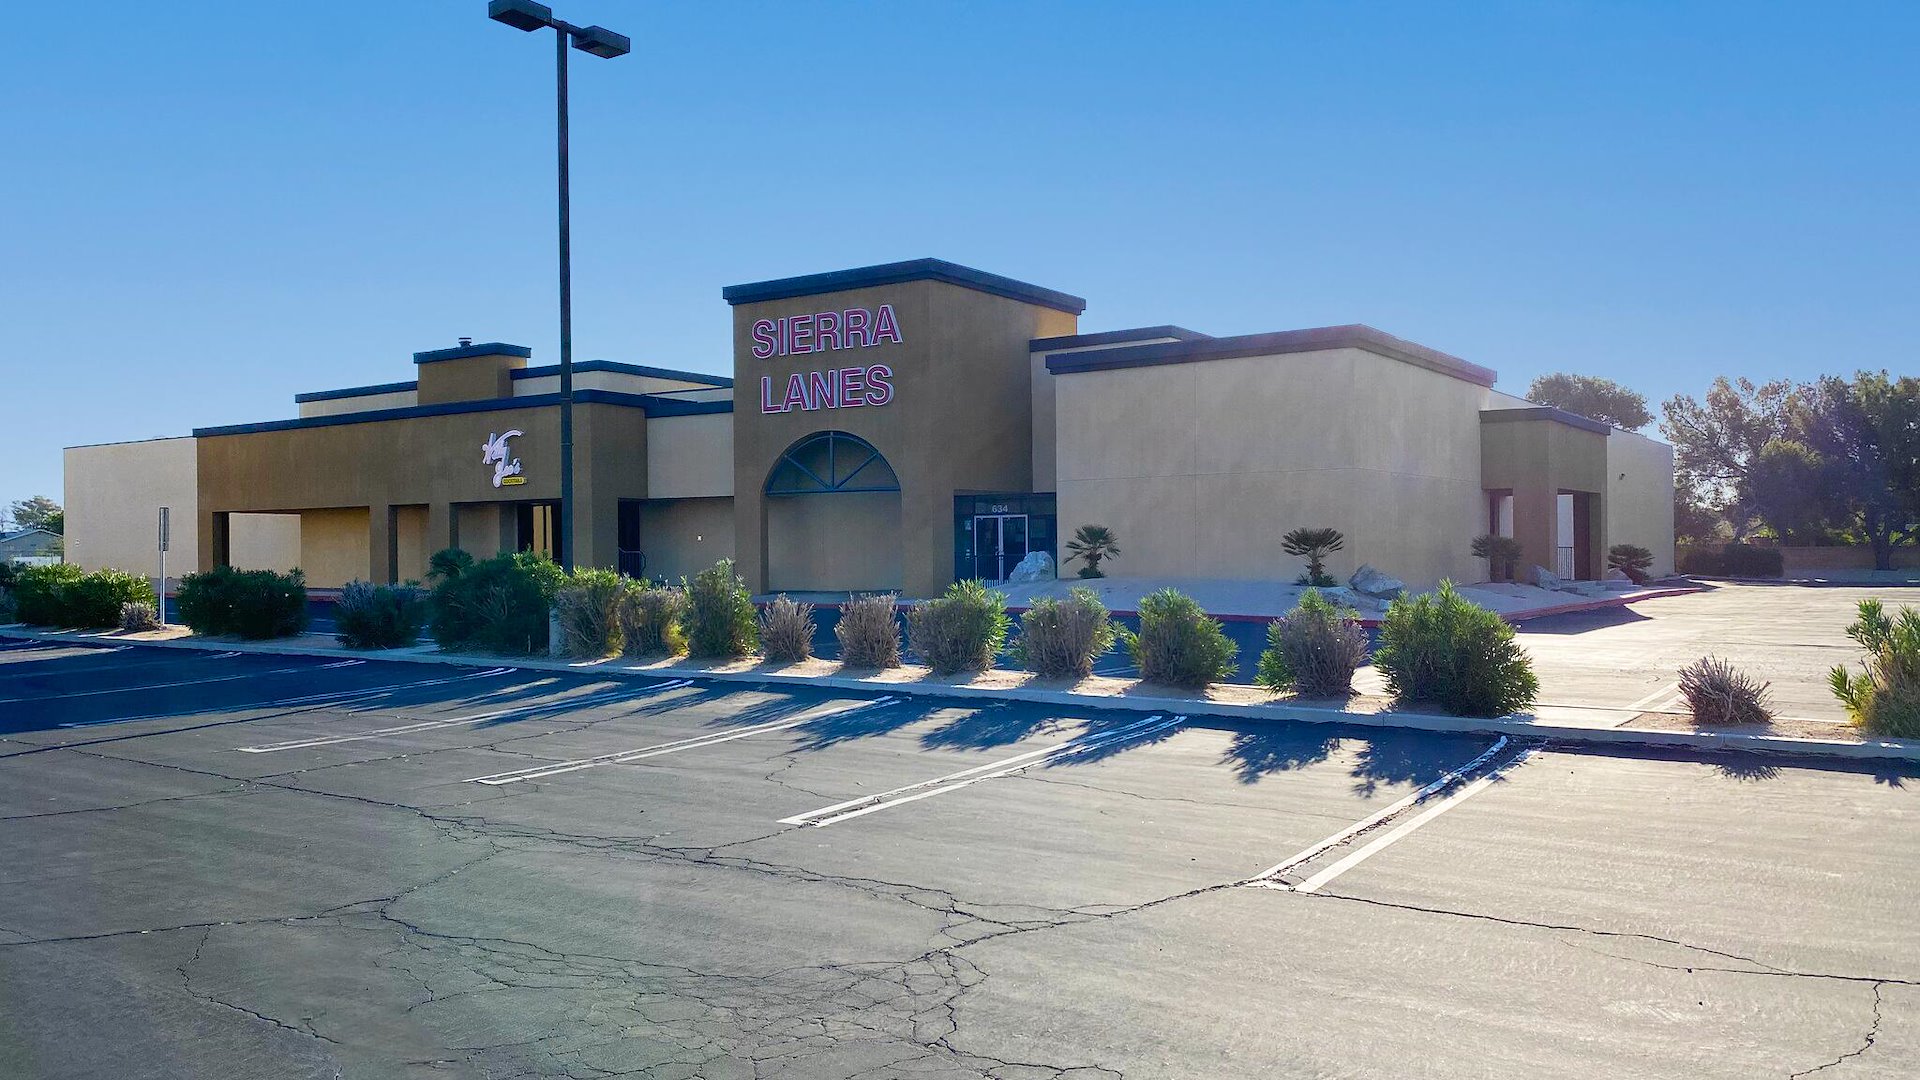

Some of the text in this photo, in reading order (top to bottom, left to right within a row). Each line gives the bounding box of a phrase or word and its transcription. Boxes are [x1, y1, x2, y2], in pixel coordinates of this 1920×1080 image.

[752, 304, 903, 359] SIERRA
[761, 364, 895, 414] LANES
[992, 504, 1008, 513] 634
